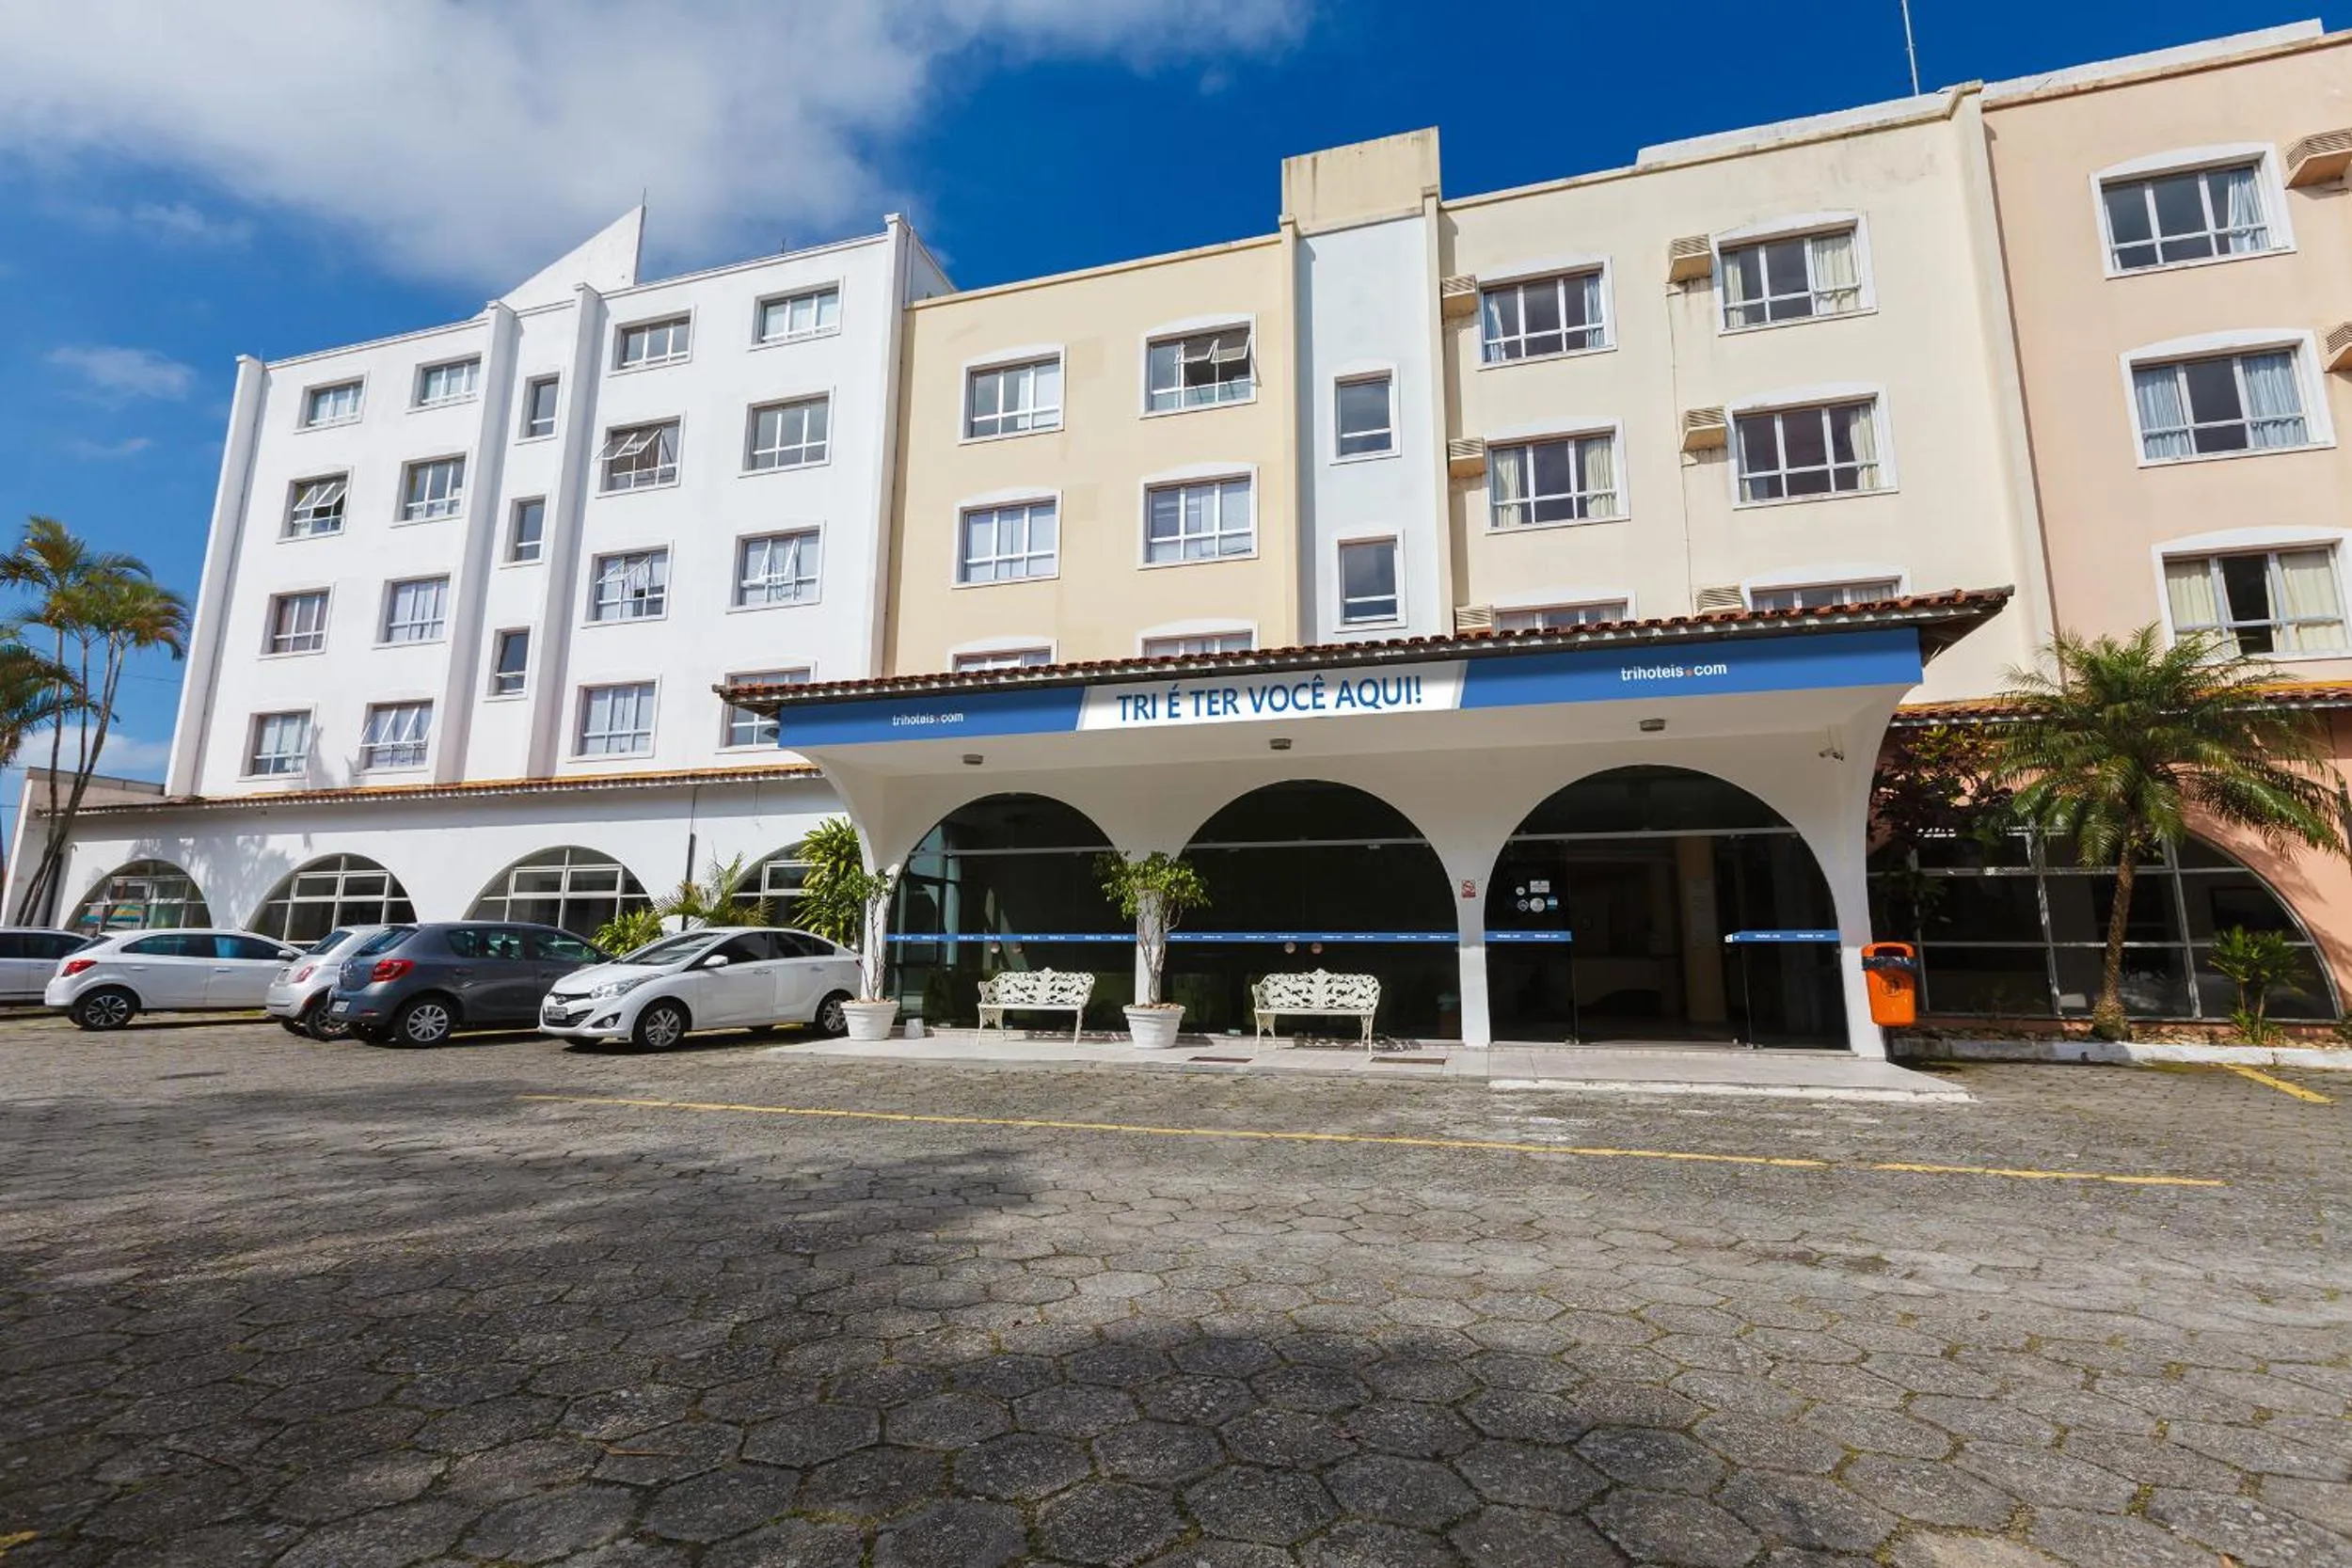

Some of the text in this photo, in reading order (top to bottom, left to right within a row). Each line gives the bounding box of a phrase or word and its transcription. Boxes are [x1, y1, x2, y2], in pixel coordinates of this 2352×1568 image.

[1620, 663, 1727, 681] trihoteis.com
[1116, 673, 1422, 721] TRI É TER VOCÊ AQUI!
